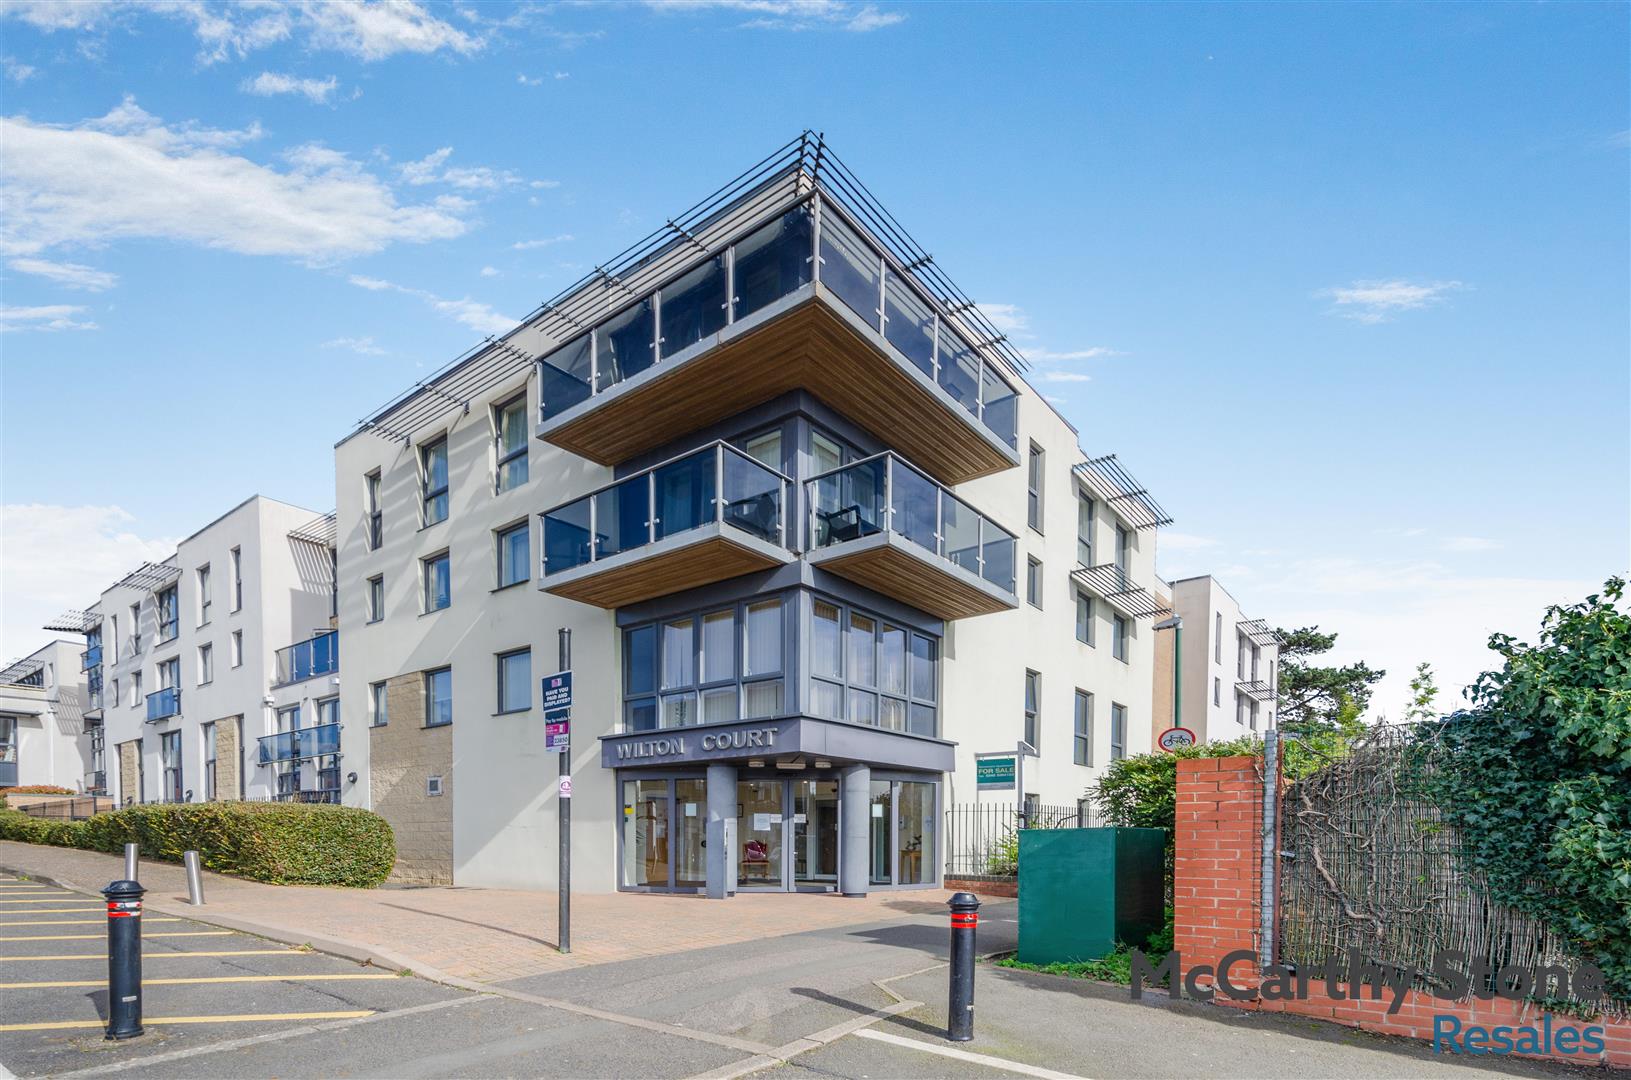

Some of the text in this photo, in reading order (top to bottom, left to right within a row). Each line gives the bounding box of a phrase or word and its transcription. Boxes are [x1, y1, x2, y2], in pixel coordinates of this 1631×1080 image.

[544, 697, 570, 707] DISPLAYED?
[616, 728, 778, 760] WILTON COURT
